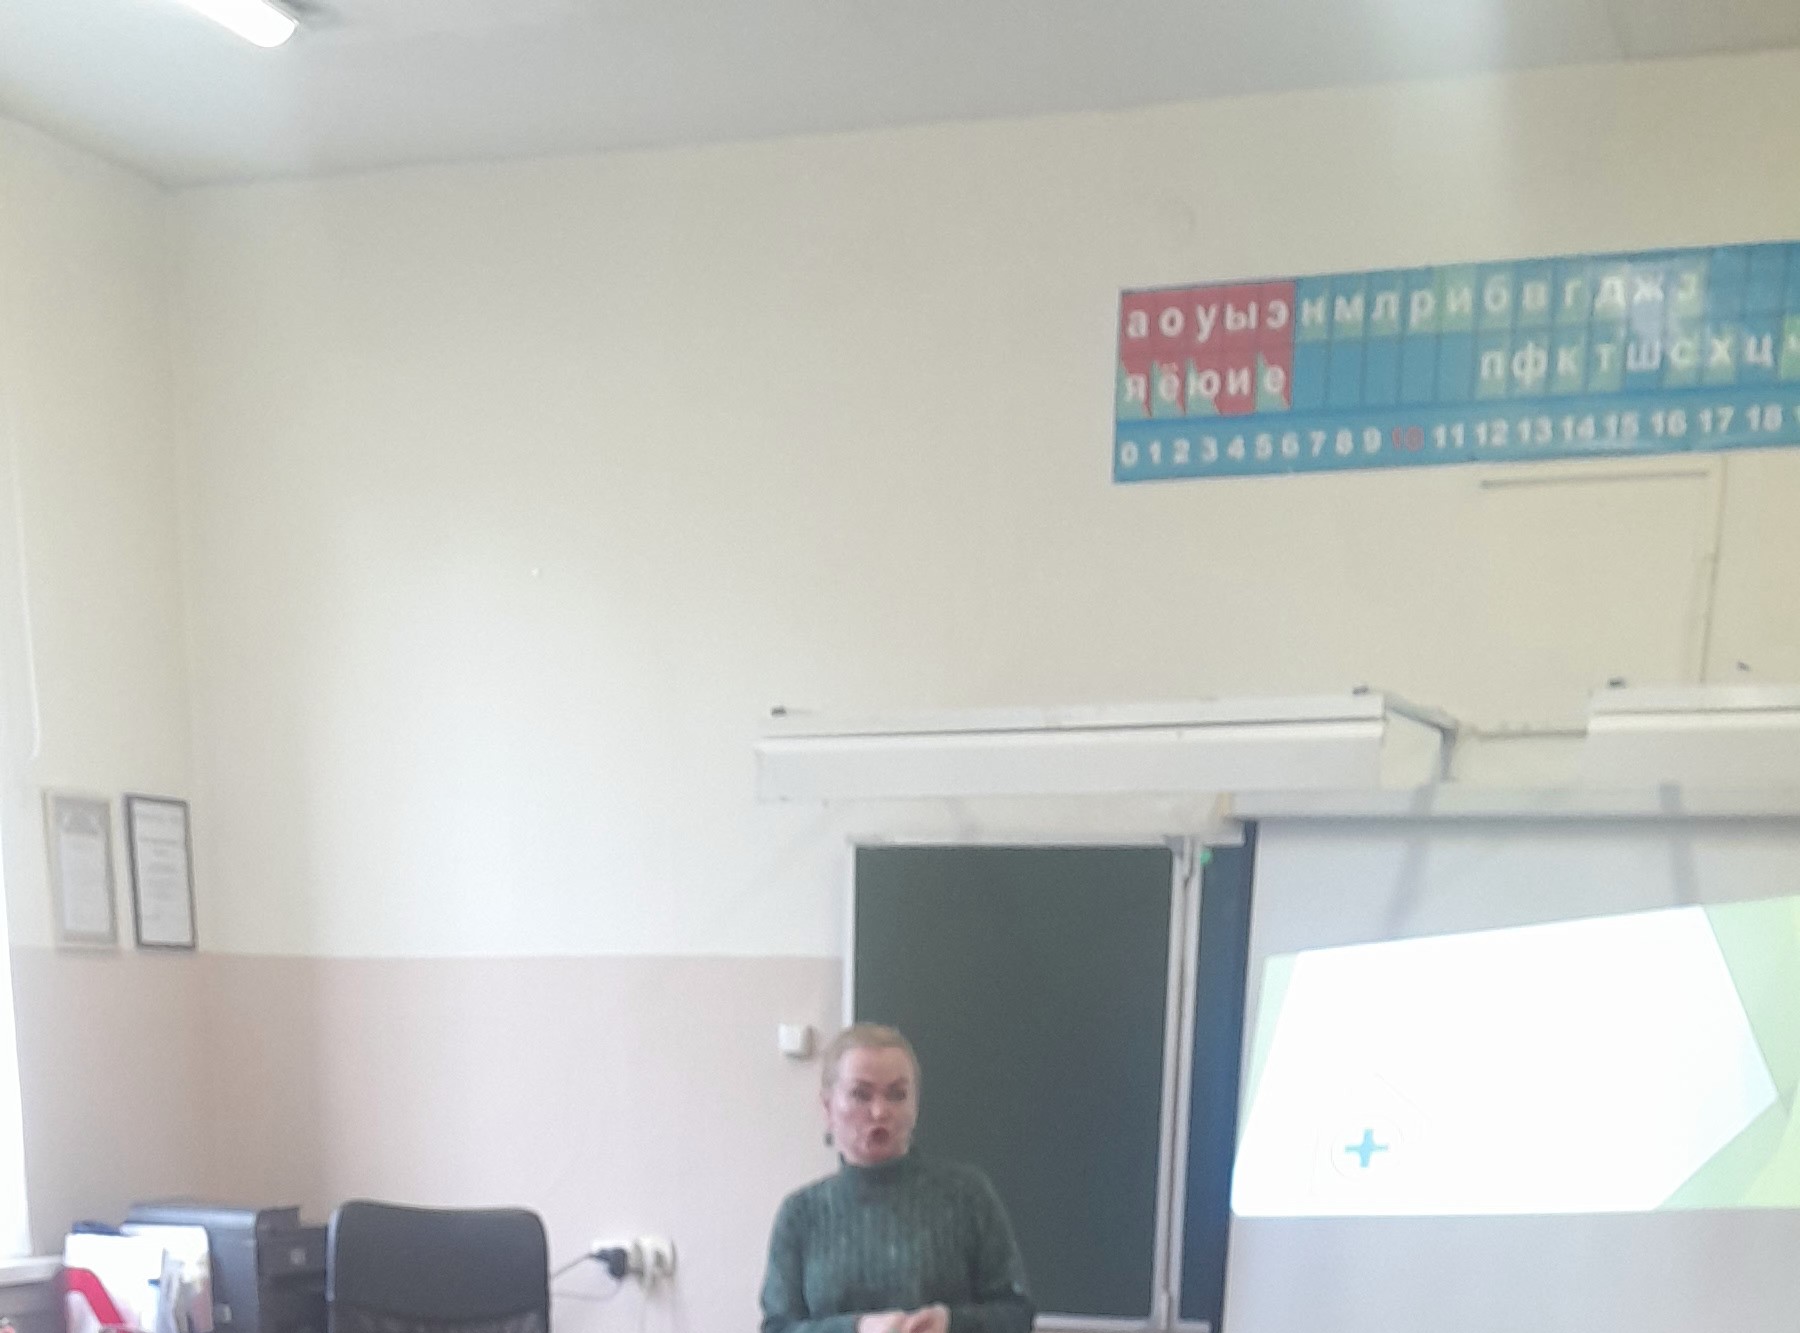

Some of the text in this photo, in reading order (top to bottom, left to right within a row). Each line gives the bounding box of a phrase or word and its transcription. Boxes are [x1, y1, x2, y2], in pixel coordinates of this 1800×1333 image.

[1127, 309, 1149, 338] а
[1158, 307, 1184, 337] о
[1196, 303, 1217, 343] у
[1225, 301, 1258, 331] ы
[1266, 300, 1289, 329] э
[1334, 295, 1364, 322] м
[1371, 291, 1399, 320] л
[1409, 289, 1435, 328] р
[1595, 276, 1626, 309] д
[1633, 273, 1664, 304] ж
[1188, 369, 1221, 398] ю
[1228, 367, 1250, 395] и
[1480, 351, 1505, 380] п
[1513, 341, 1548, 388] ф
[1597, 343, 1616, 373] т
[1626, 342, 1662, 372] ш
[1709, 336, 1732, 368] х
[1744, 334, 1774, 369] ц
[1120, 440, 1138, 468] 0
[1150, 439, 1162, 465] 1
[1173, 437, 1191, 464] 2
[1201, 435, 1219, 463] 3
[1227, 434, 1246, 460] 4
[1309, 429, 1327, 457] 7
[1335, 427, 1354, 455] 8
[1391, 424, 1424, 453] 10
[1433, 421, 1466, 449] 11
[1475, 420, 1508, 447] 12
[1518, 416, 1553, 444] 13
[1561, 414, 1596, 443] 14
[1699, 406, 1734, 433] 17
[1747, 404, 1783, 432] 18
